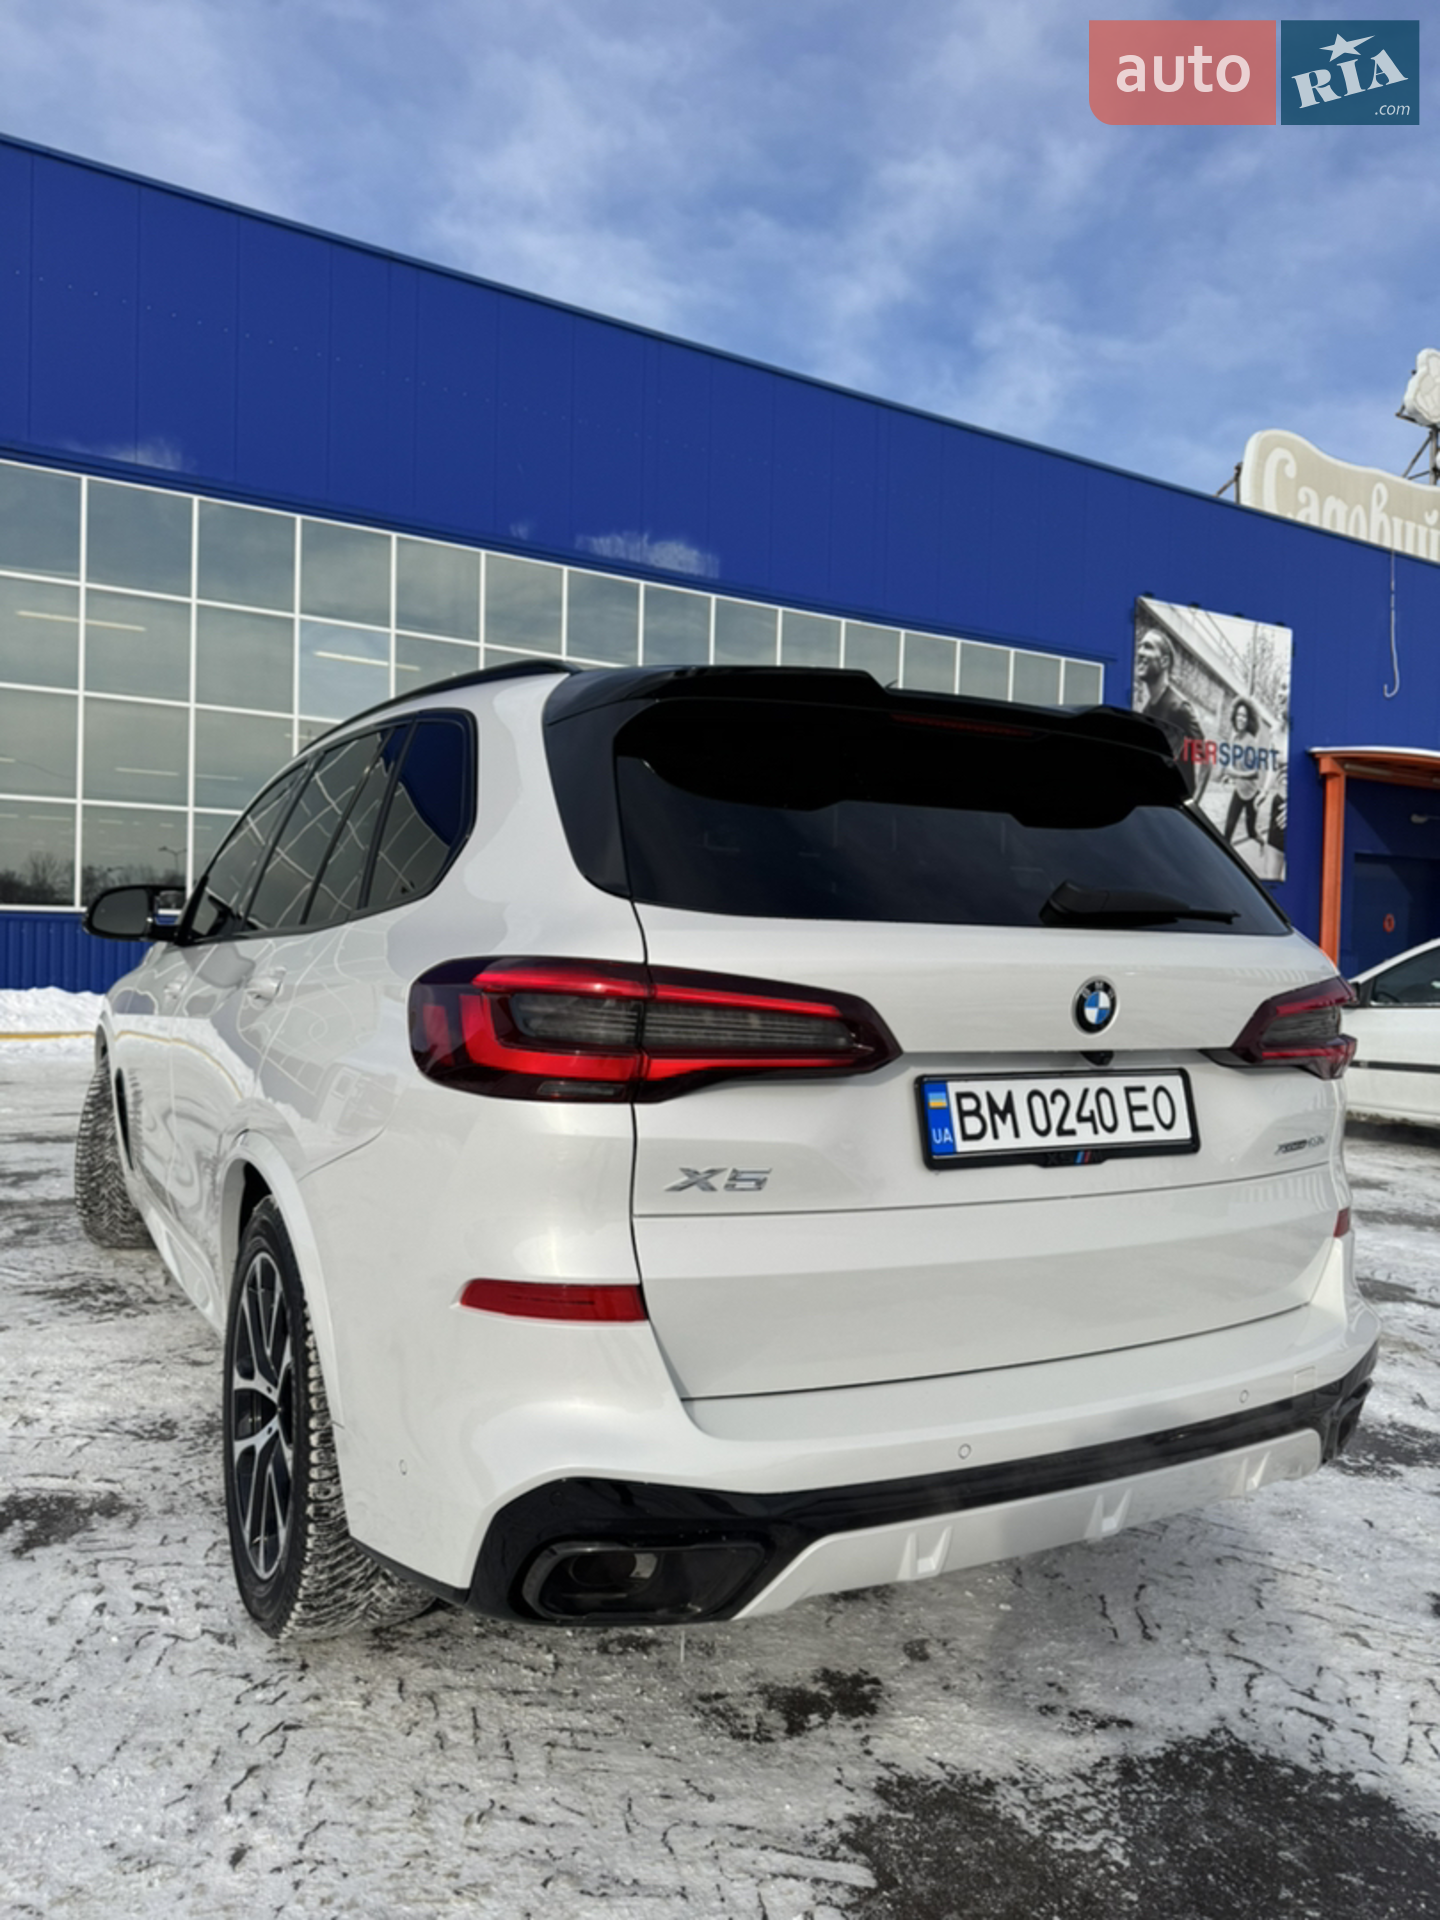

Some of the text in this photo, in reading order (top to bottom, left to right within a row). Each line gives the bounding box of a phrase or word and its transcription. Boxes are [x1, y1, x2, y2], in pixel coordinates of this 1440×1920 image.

[1174, 736, 1279, 772] TERSPORT
[954, 1084, 1177, 1142] BM 0240 EO
[932, 1126, 954, 1145] UA
[663, 1166, 773, 1192] X5
